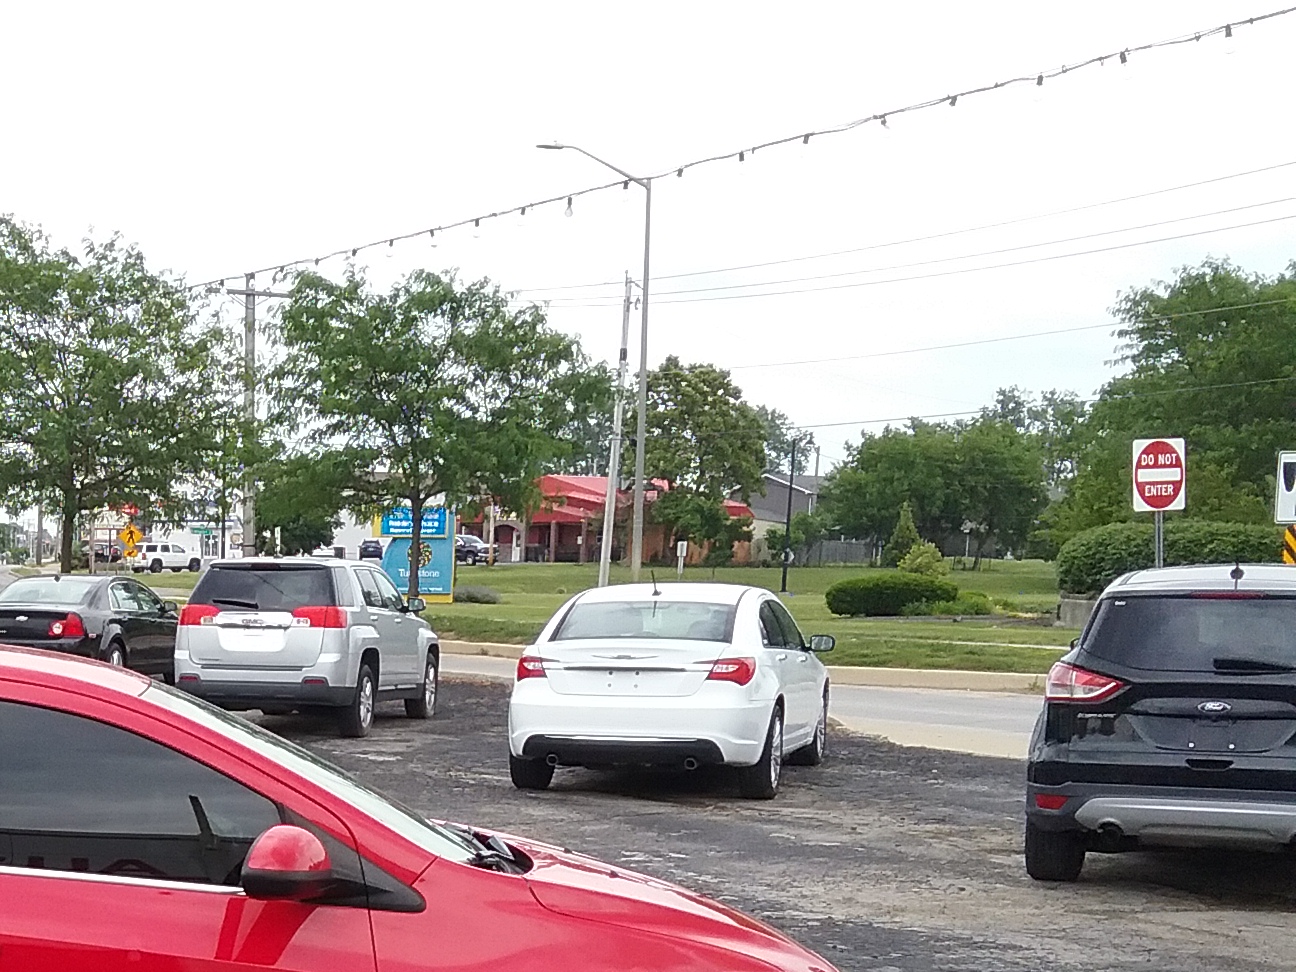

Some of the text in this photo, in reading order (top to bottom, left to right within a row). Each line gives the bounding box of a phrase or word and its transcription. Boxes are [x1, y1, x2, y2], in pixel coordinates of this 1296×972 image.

[1141, 453, 1178, 465] DO NOT
[1144, 484, 1174, 497] ENTER
